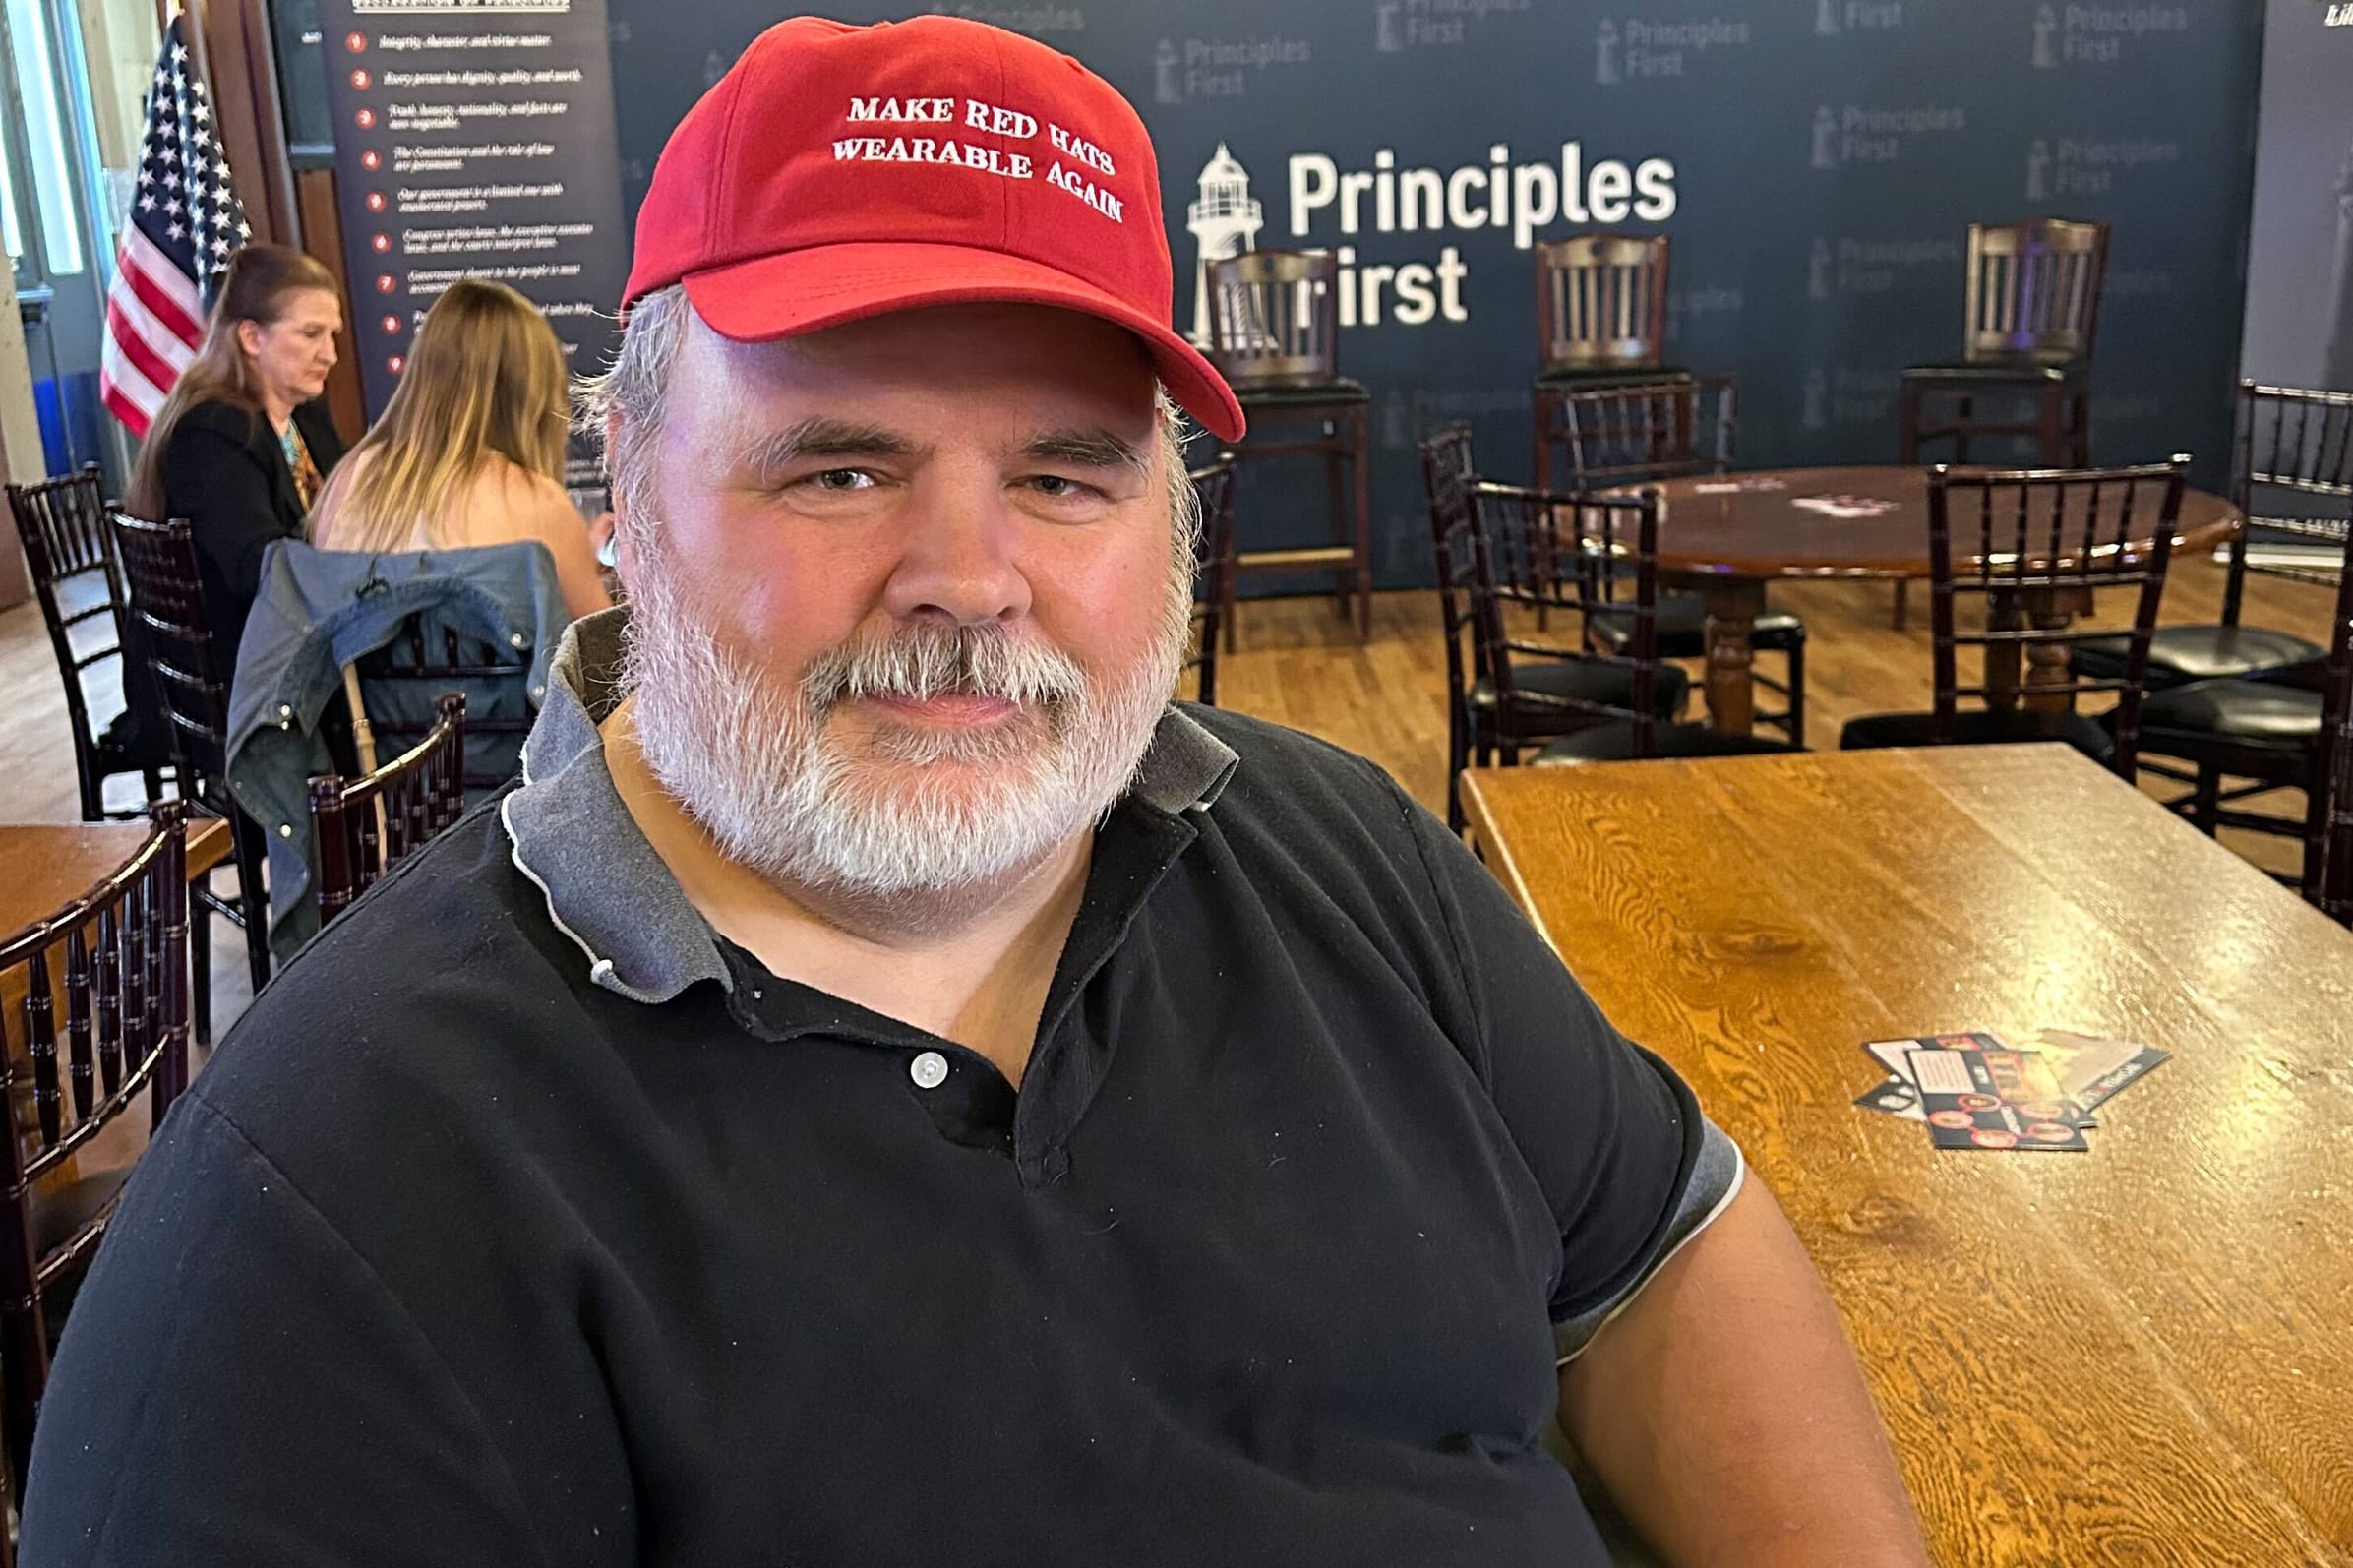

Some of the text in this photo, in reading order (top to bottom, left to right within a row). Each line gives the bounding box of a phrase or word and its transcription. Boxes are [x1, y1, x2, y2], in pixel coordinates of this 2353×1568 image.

[1625, 17, 1750, 50] Principles
[1185, 37, 1311, 70] Principles
[1624, 50, 1683, 78] First
[1185, 70, 1245, 95] First
[846, 96, 1116, 176] MAKE RED HATS
[832, 137, 1124, 223] WEARABLE AGAIN
[1290, 141, 1677, 249] Principles
